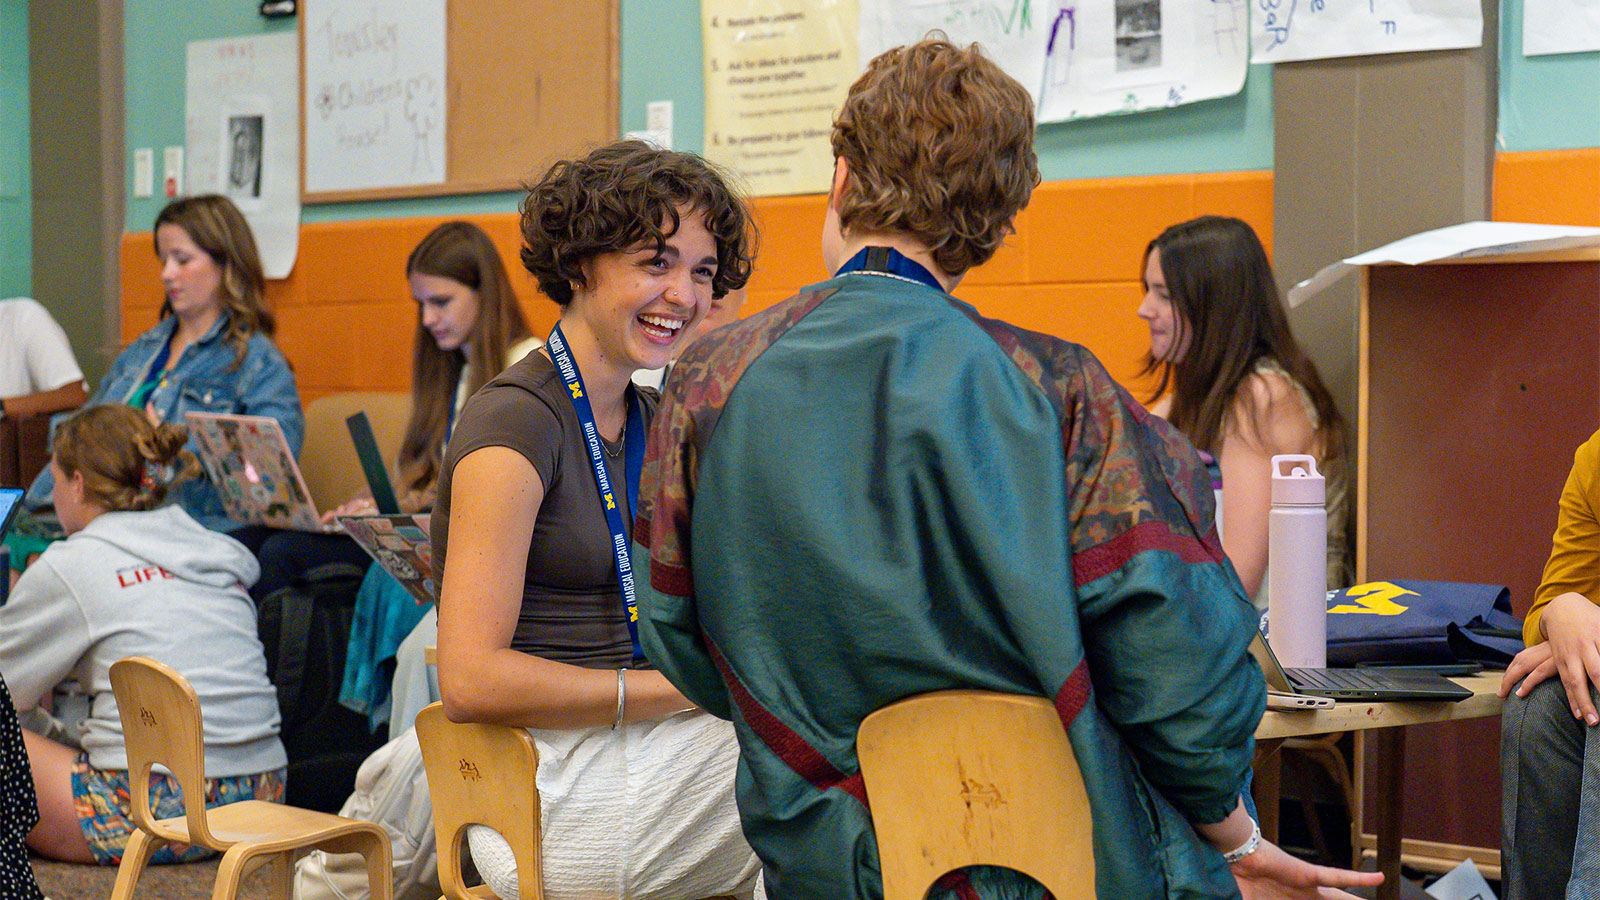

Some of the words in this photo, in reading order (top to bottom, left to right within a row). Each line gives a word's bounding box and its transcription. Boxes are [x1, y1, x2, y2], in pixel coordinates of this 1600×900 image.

[556, 351, 577, 380] MARSAL
[583, 421, 602, 460] EDUCATION
[596, 460, 610, 491] MARSAL
[614, 533, 631, 573] EDUCATION
[621, 572, 636, 603] MARSAL
